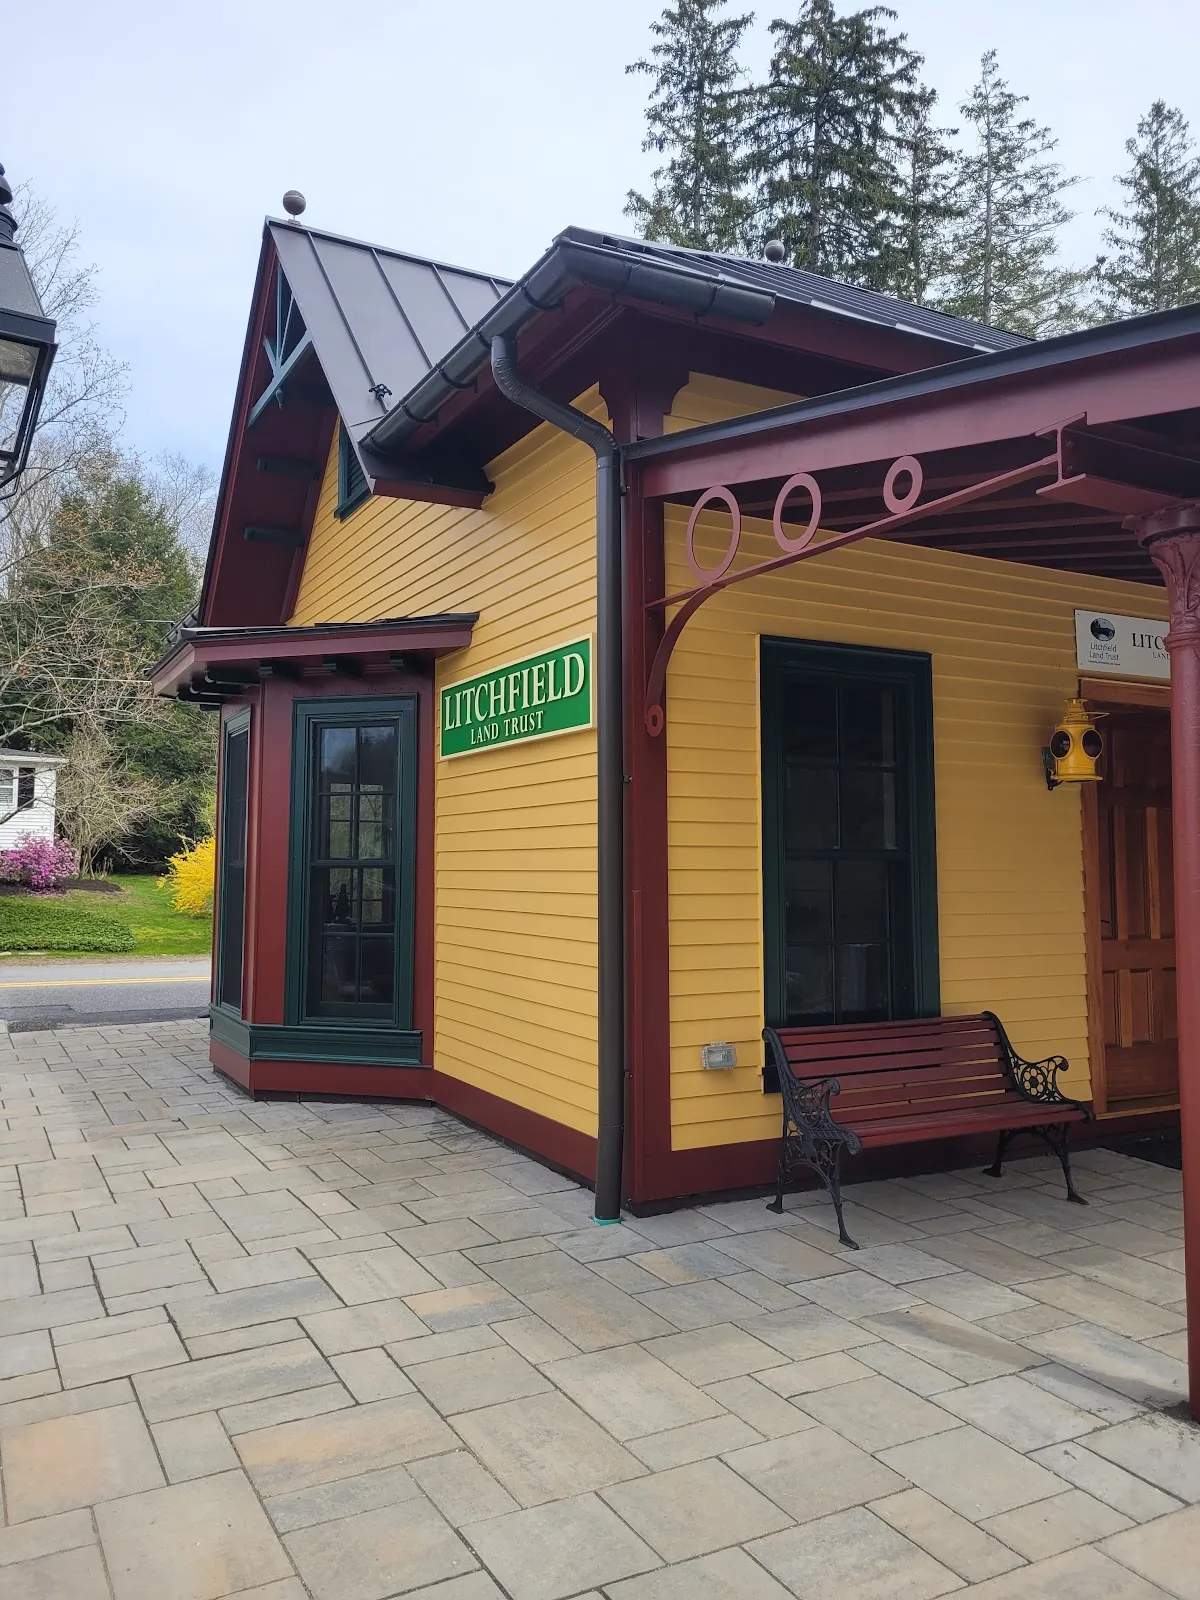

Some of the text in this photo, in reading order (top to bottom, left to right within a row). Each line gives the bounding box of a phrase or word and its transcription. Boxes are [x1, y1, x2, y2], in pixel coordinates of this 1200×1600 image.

[1090, 642, 1117, 653] Litchfield
[1132, 632, 1165, 651] LITC
[1089, 651, 1119, 661] Land Trust
[444, 652, 585, 731] LITCHFIELD
[471, 710, 544, 745] LAND TRUST
